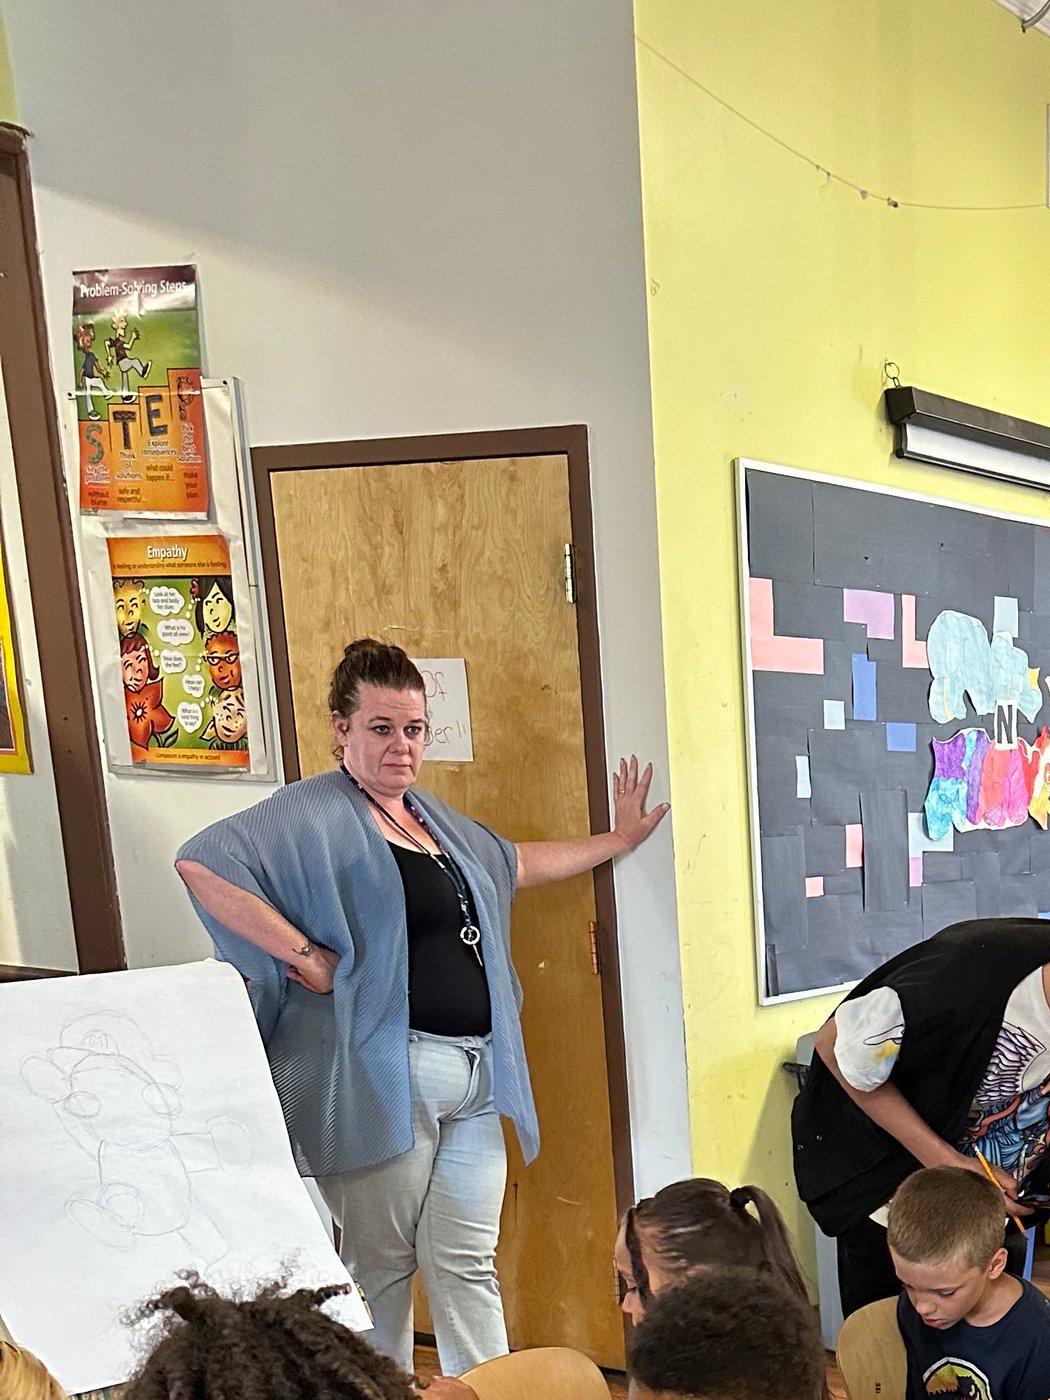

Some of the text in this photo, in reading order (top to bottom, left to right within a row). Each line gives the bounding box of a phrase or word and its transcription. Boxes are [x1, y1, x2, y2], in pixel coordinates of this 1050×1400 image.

[80, 280, 186, 298] Problem-Solving Steps
[147, 544, 188, 561] Empathy
[997, 704, 1013, 744] N
